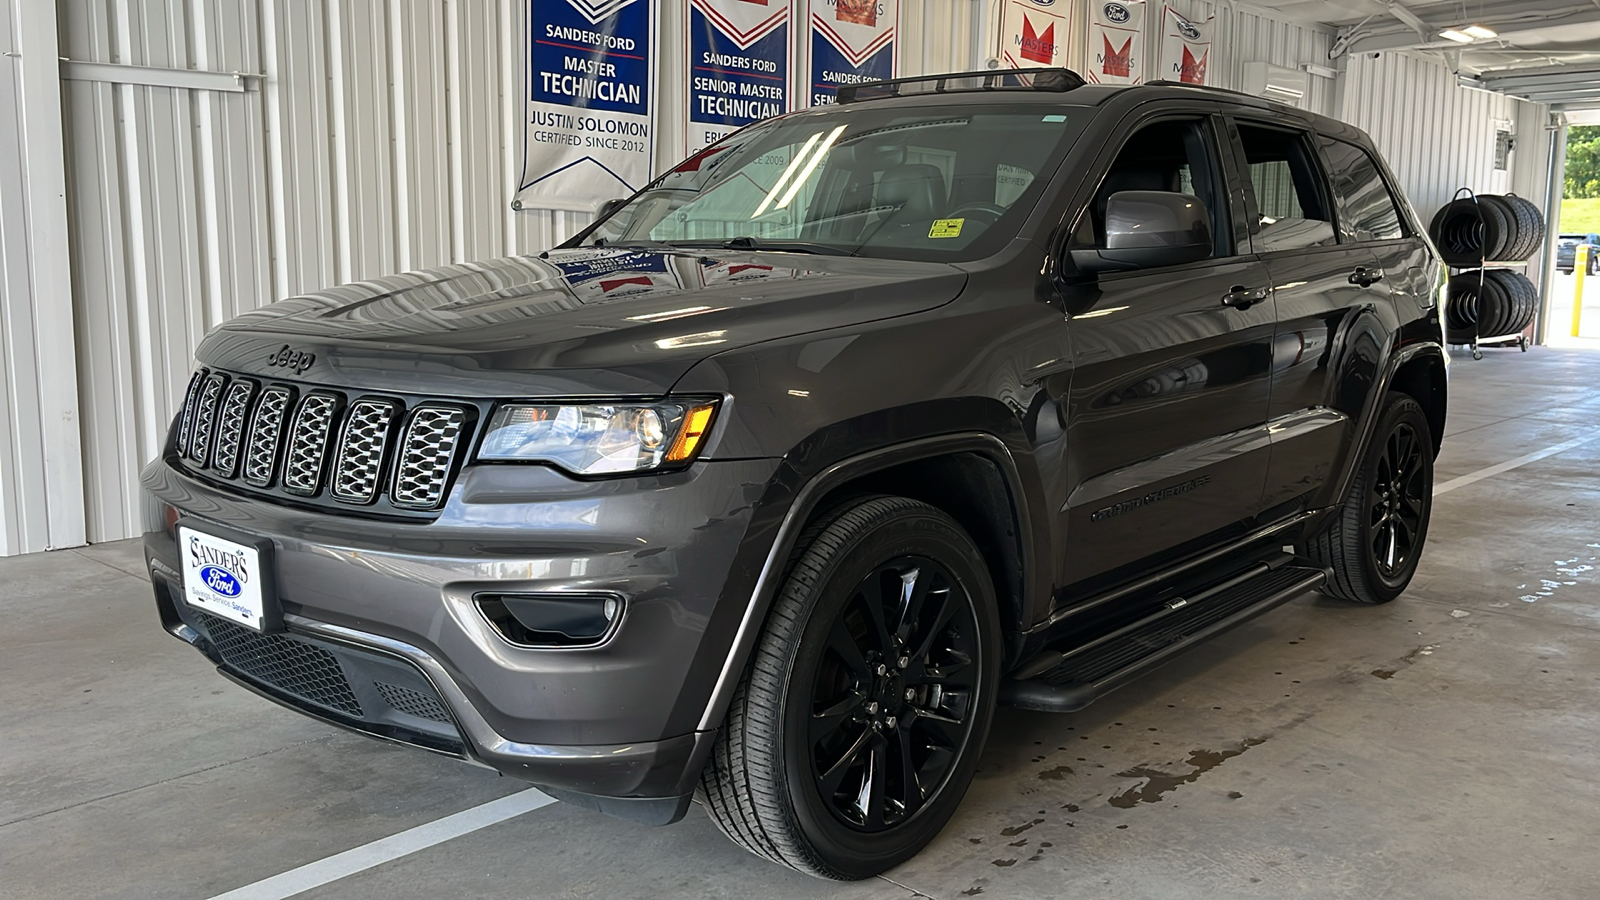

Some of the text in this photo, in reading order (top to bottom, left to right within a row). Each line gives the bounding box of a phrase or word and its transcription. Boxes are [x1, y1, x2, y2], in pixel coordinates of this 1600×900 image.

[546, 24, 635, 51] SANDERS FORD
[1015, 34, 1059, 56] MASTERS
[564, 56, 617, 78] MASTER
[703, 51, 777, 73] SANDERS FORD
[540, 71, 640, 105] TECHNICIAN
[694, 77, 783, 100] SENIOR MASTER
[822, 70, 861, 84] SANDERS
[698, 95, 780, 120] TECHNICIAN
[531, 110, 648, 138] JUSTIN SOLOMON
[534, 130, 645, 153] CERTIFIED SINCE 2012
[765, 155, 785, 166] 2009
[266, 344, 317, 376] Jeep
[1090, 474, 1212, 523] GRAND CHEROKEE
[190, 540, 249, 584] SANDERS
[207, 567, 235, 595] Ford
[191, 586, 212, 601] Savings.
[231, 601, 254, 617] Sanders.
